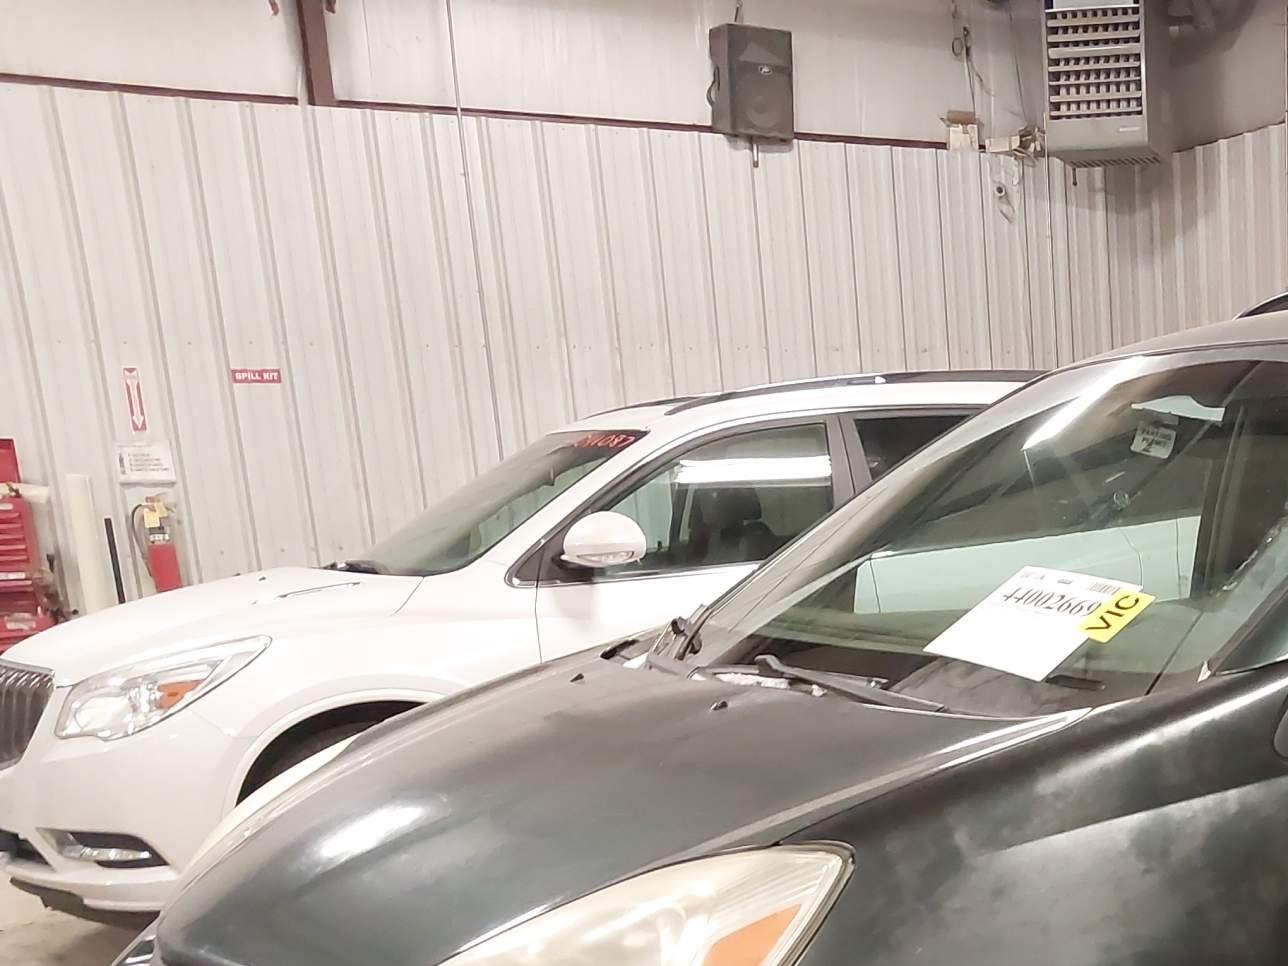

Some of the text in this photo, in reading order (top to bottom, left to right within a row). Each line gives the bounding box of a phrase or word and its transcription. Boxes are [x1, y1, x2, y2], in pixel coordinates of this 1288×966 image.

[235, 372, 278, 380] SPILL KIT
[1003, 587, 1102, 616] 44002669
[1085, 594, 1140, 631] VIC
